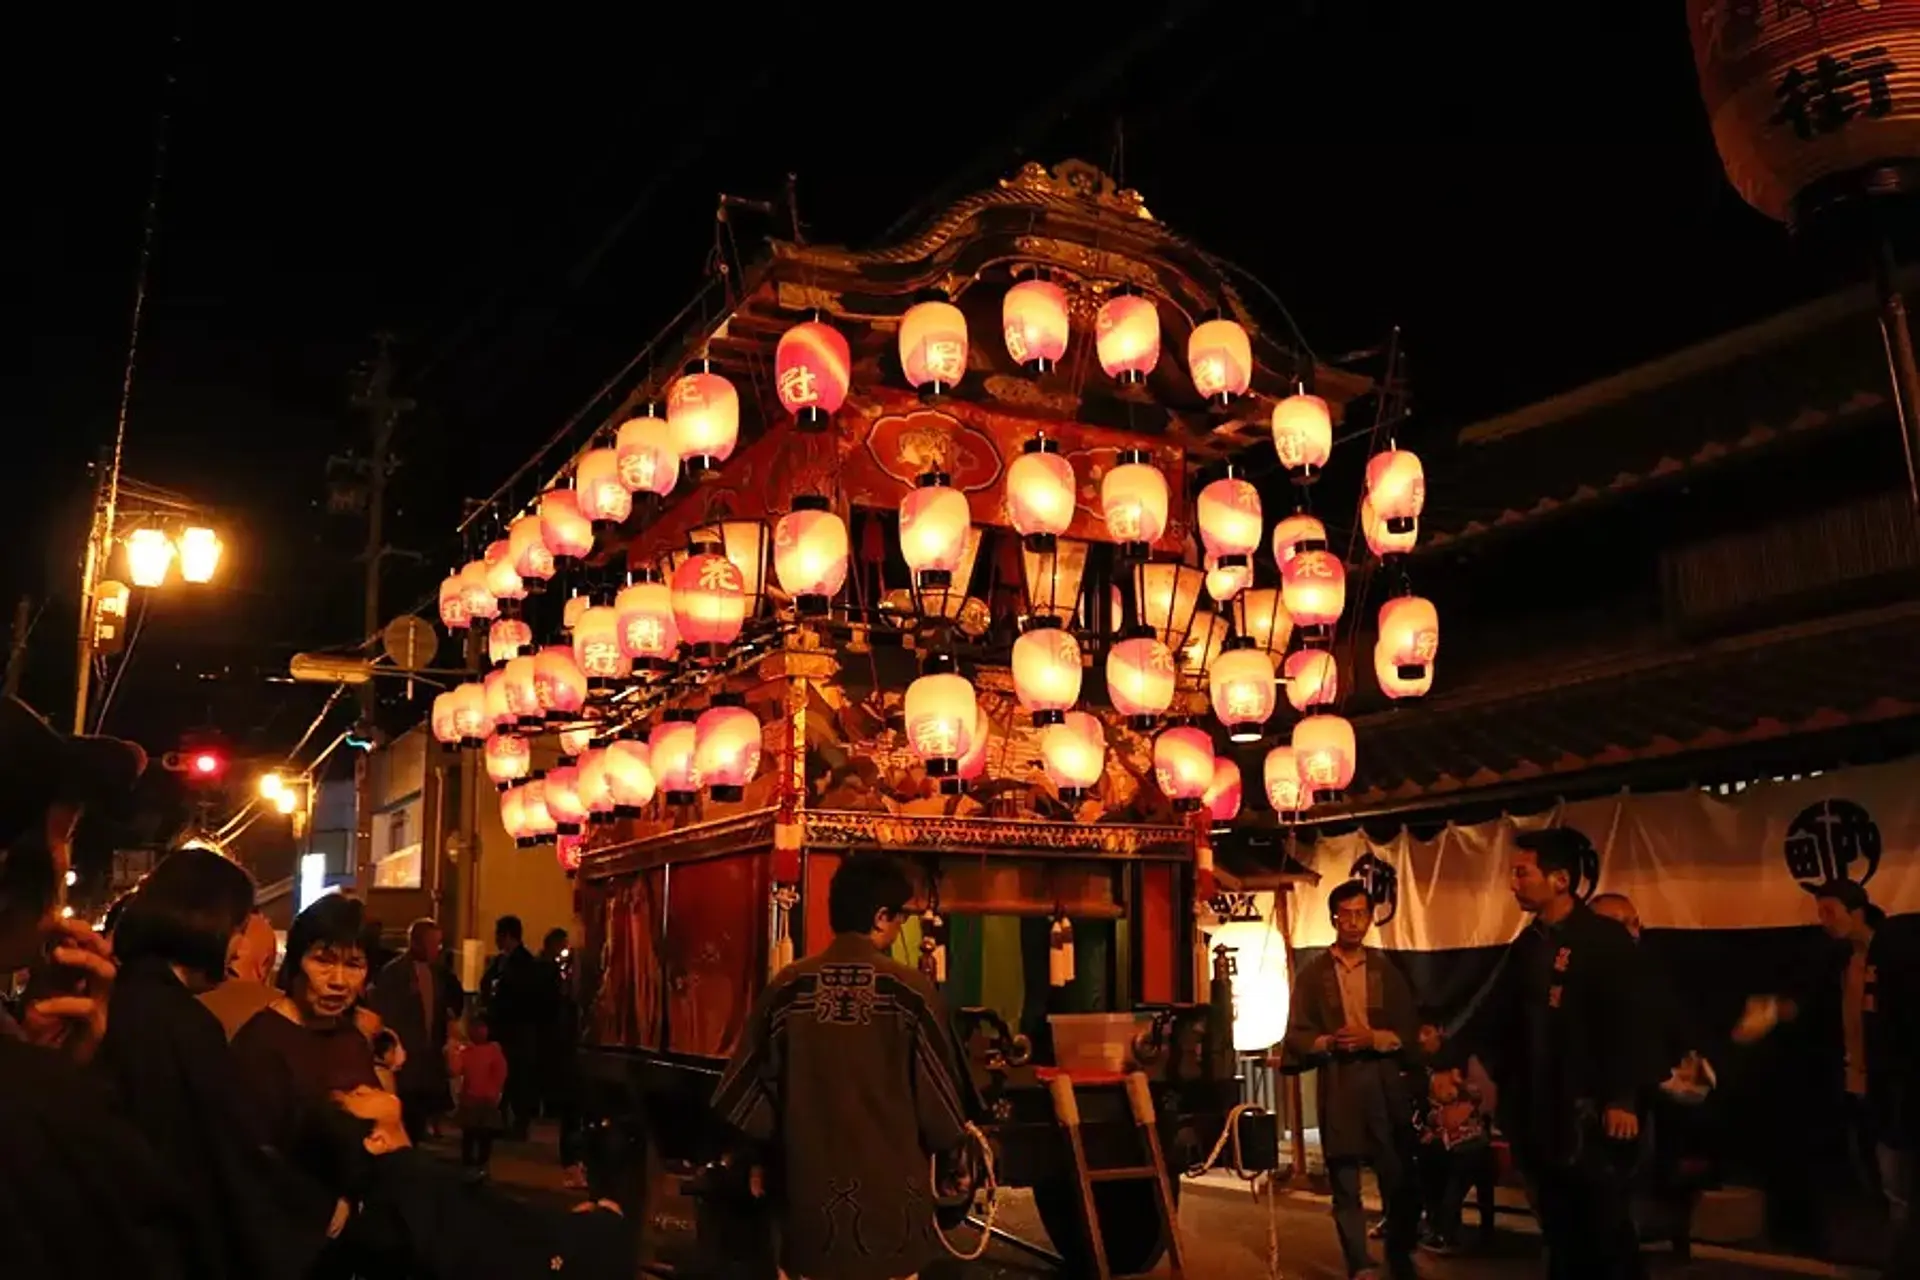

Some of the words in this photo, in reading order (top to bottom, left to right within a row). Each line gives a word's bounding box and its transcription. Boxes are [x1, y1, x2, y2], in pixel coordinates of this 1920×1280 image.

[780, 366, 817, 403] 社
[700, 557, 740, 590] 花
[1295, 550, 1333, 576] 花
[627, 616, 663, 650] 社
[584, 642, 620, 674] 社
